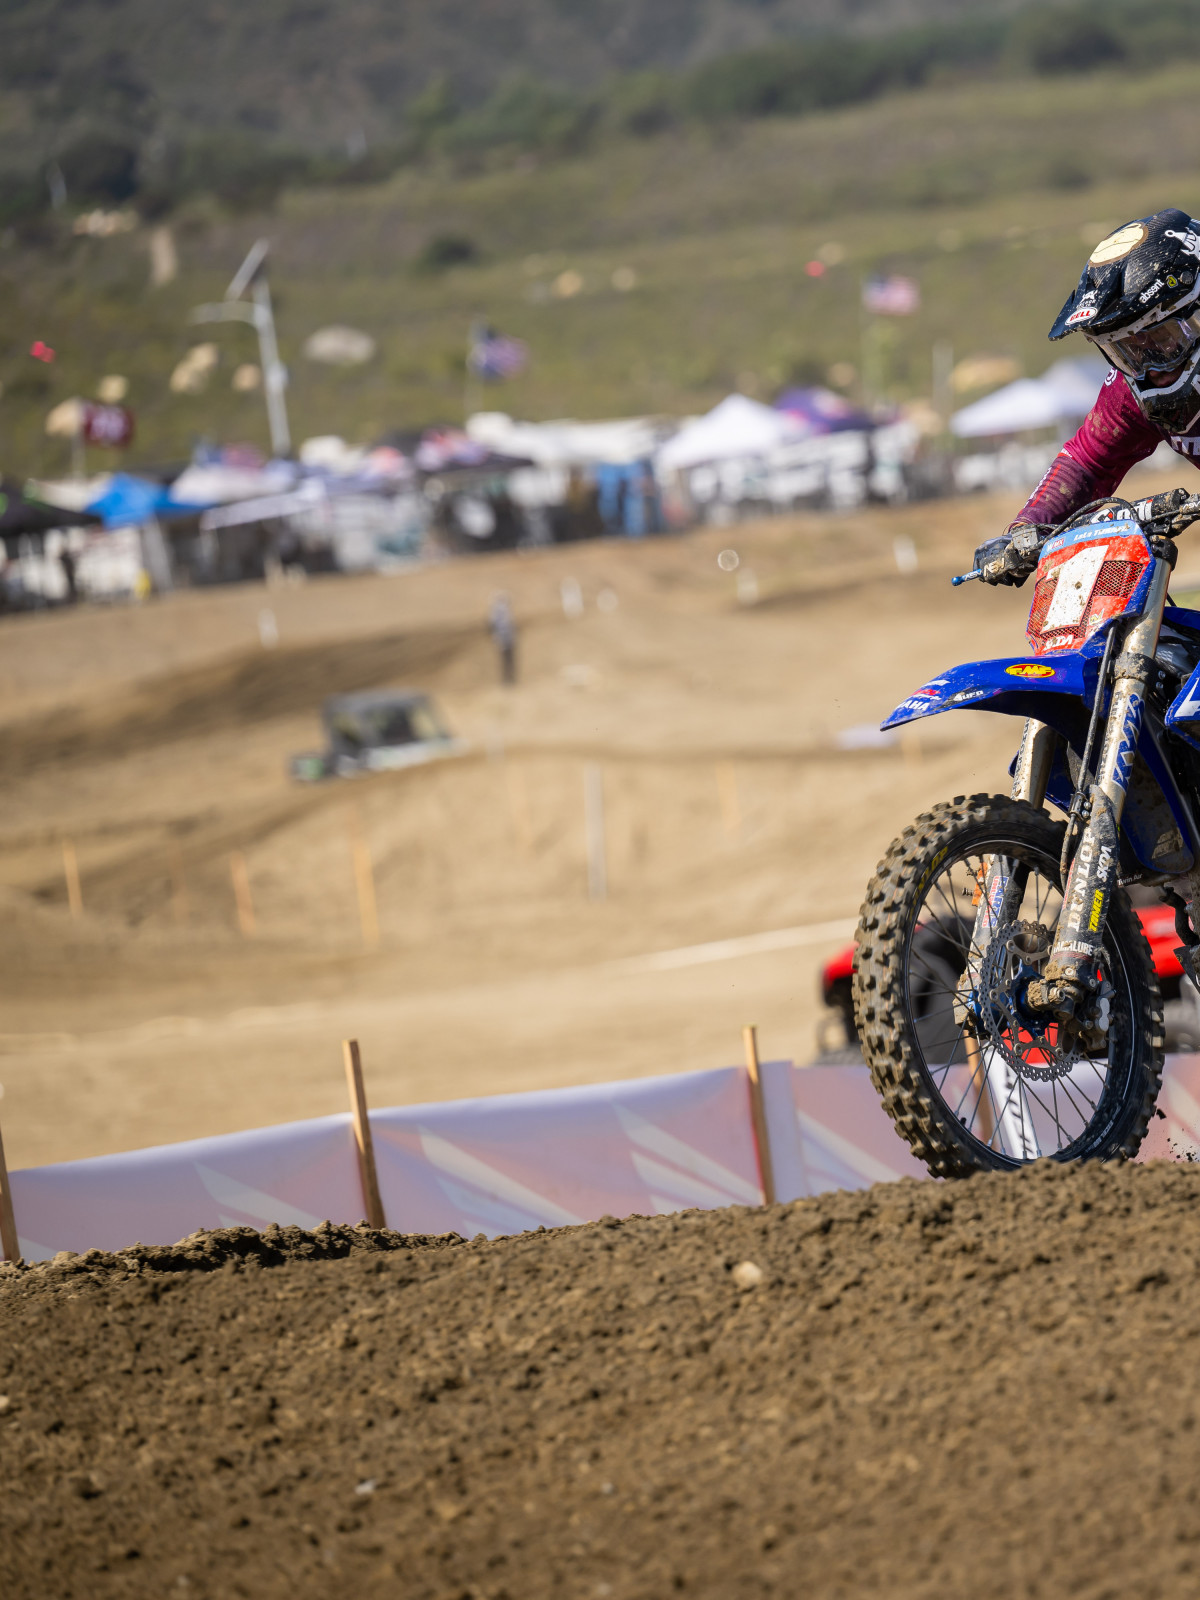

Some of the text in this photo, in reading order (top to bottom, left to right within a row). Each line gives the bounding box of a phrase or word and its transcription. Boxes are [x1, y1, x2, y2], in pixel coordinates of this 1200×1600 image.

[1070, 310, 1091, 322] BELL
[1041, 544, 1109, 633] 1
[1008, 664, 1053, 677] FMF
[961, 690, 984, 701] UFO
[1133, 872, 1144, 882] Air
